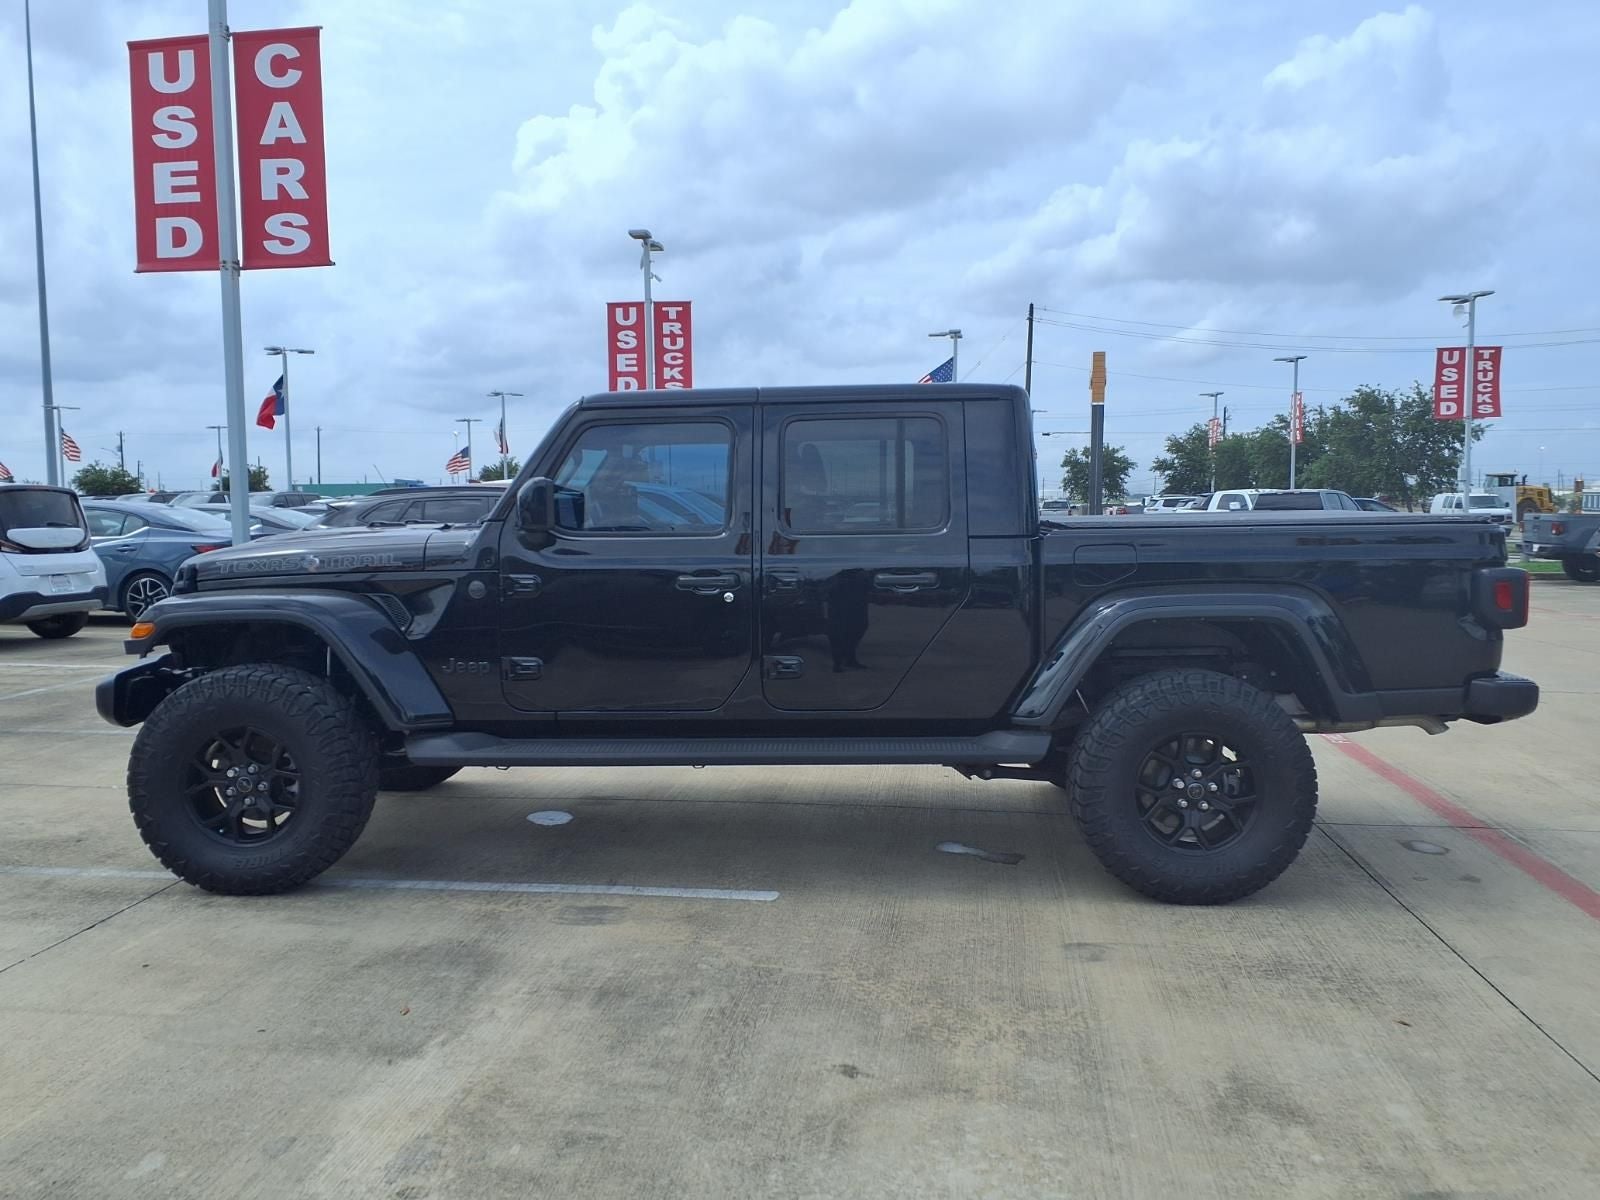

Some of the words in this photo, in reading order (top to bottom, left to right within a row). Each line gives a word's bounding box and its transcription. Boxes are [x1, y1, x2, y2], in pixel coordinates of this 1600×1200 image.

[148, 50, 203, 258] USED
[254, 43, 311, 255] CARS
[615, 307, 638, 392] USED
[1440, 351, 1459, 415] USED
[1477, 350, 1495, 414] TRUCKS
[216, 557, 301, 574] TEXAS
[319, 552, 402, 571] TRAIL
[441, 657, 490, 676] Jeep
